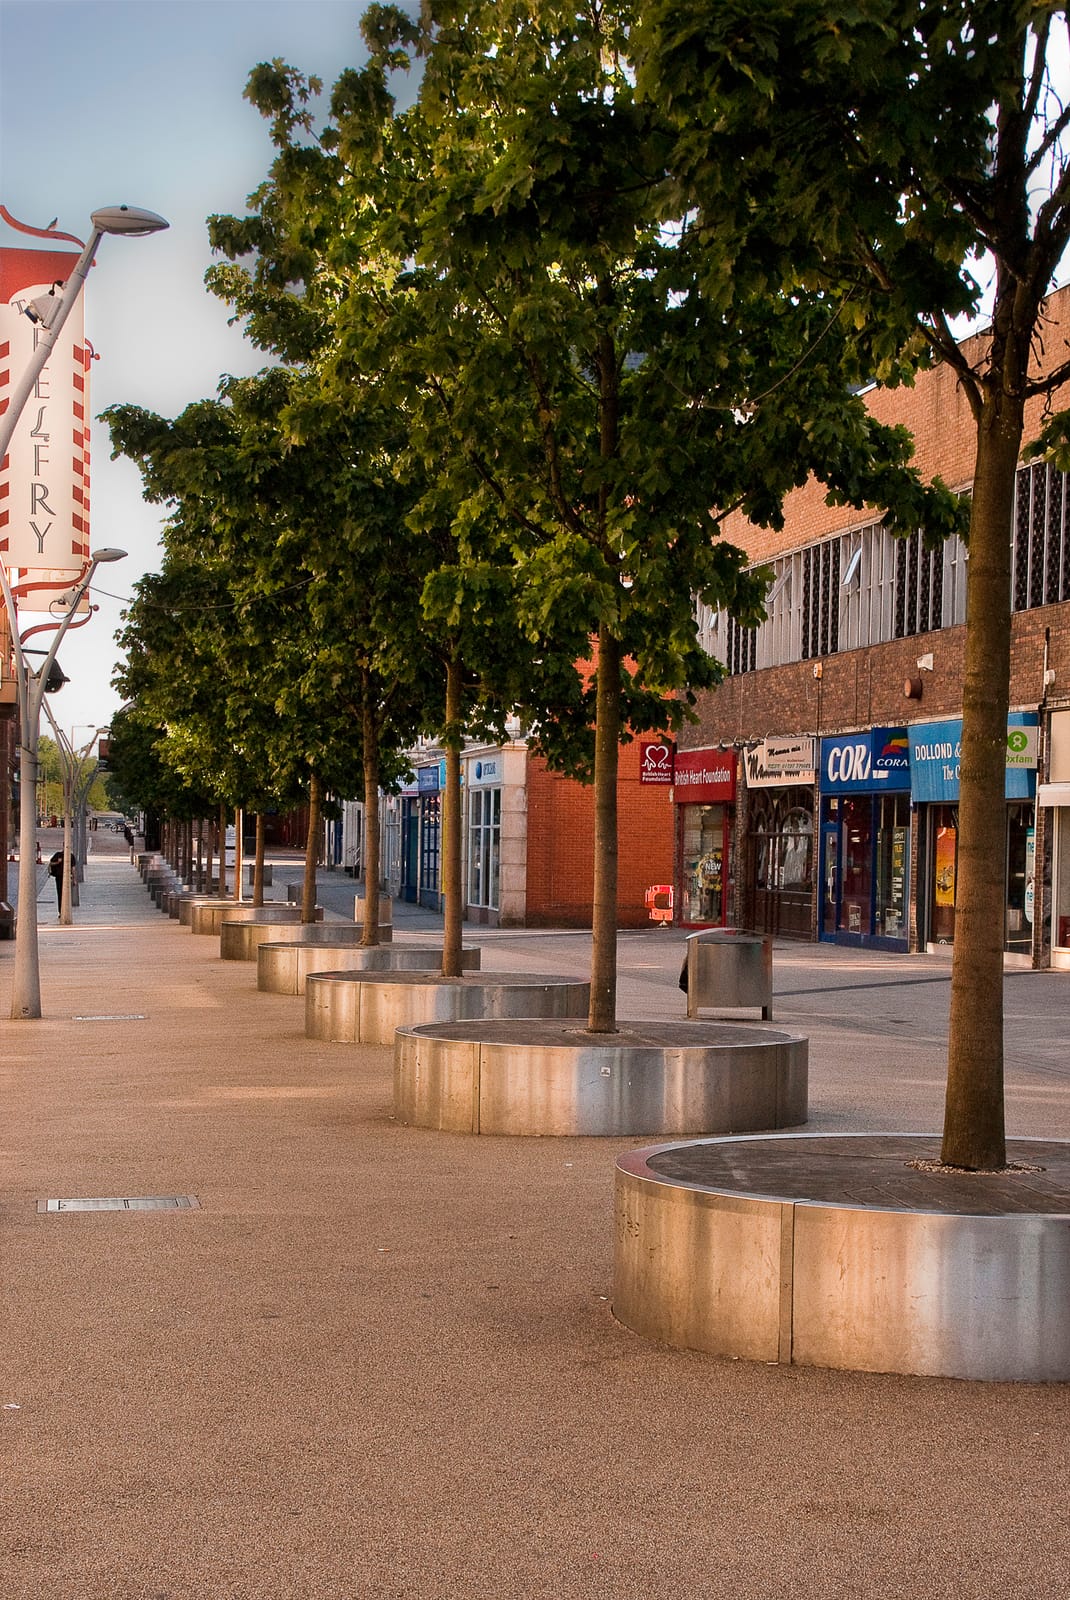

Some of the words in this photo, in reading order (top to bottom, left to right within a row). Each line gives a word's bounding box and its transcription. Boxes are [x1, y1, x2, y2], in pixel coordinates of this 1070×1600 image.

[915, 742, 952, 761] DOLLOND
[828, 744, 889, 782] COR
[876, 758, 908, 767] CORA
[675, 769, 689, 786] British
[690, 769, 702, 785] Heart
[703, 766, 730, 784] Foundation
[942, 765, 954, 780] The
[705, 861, 721, 871] NEW
